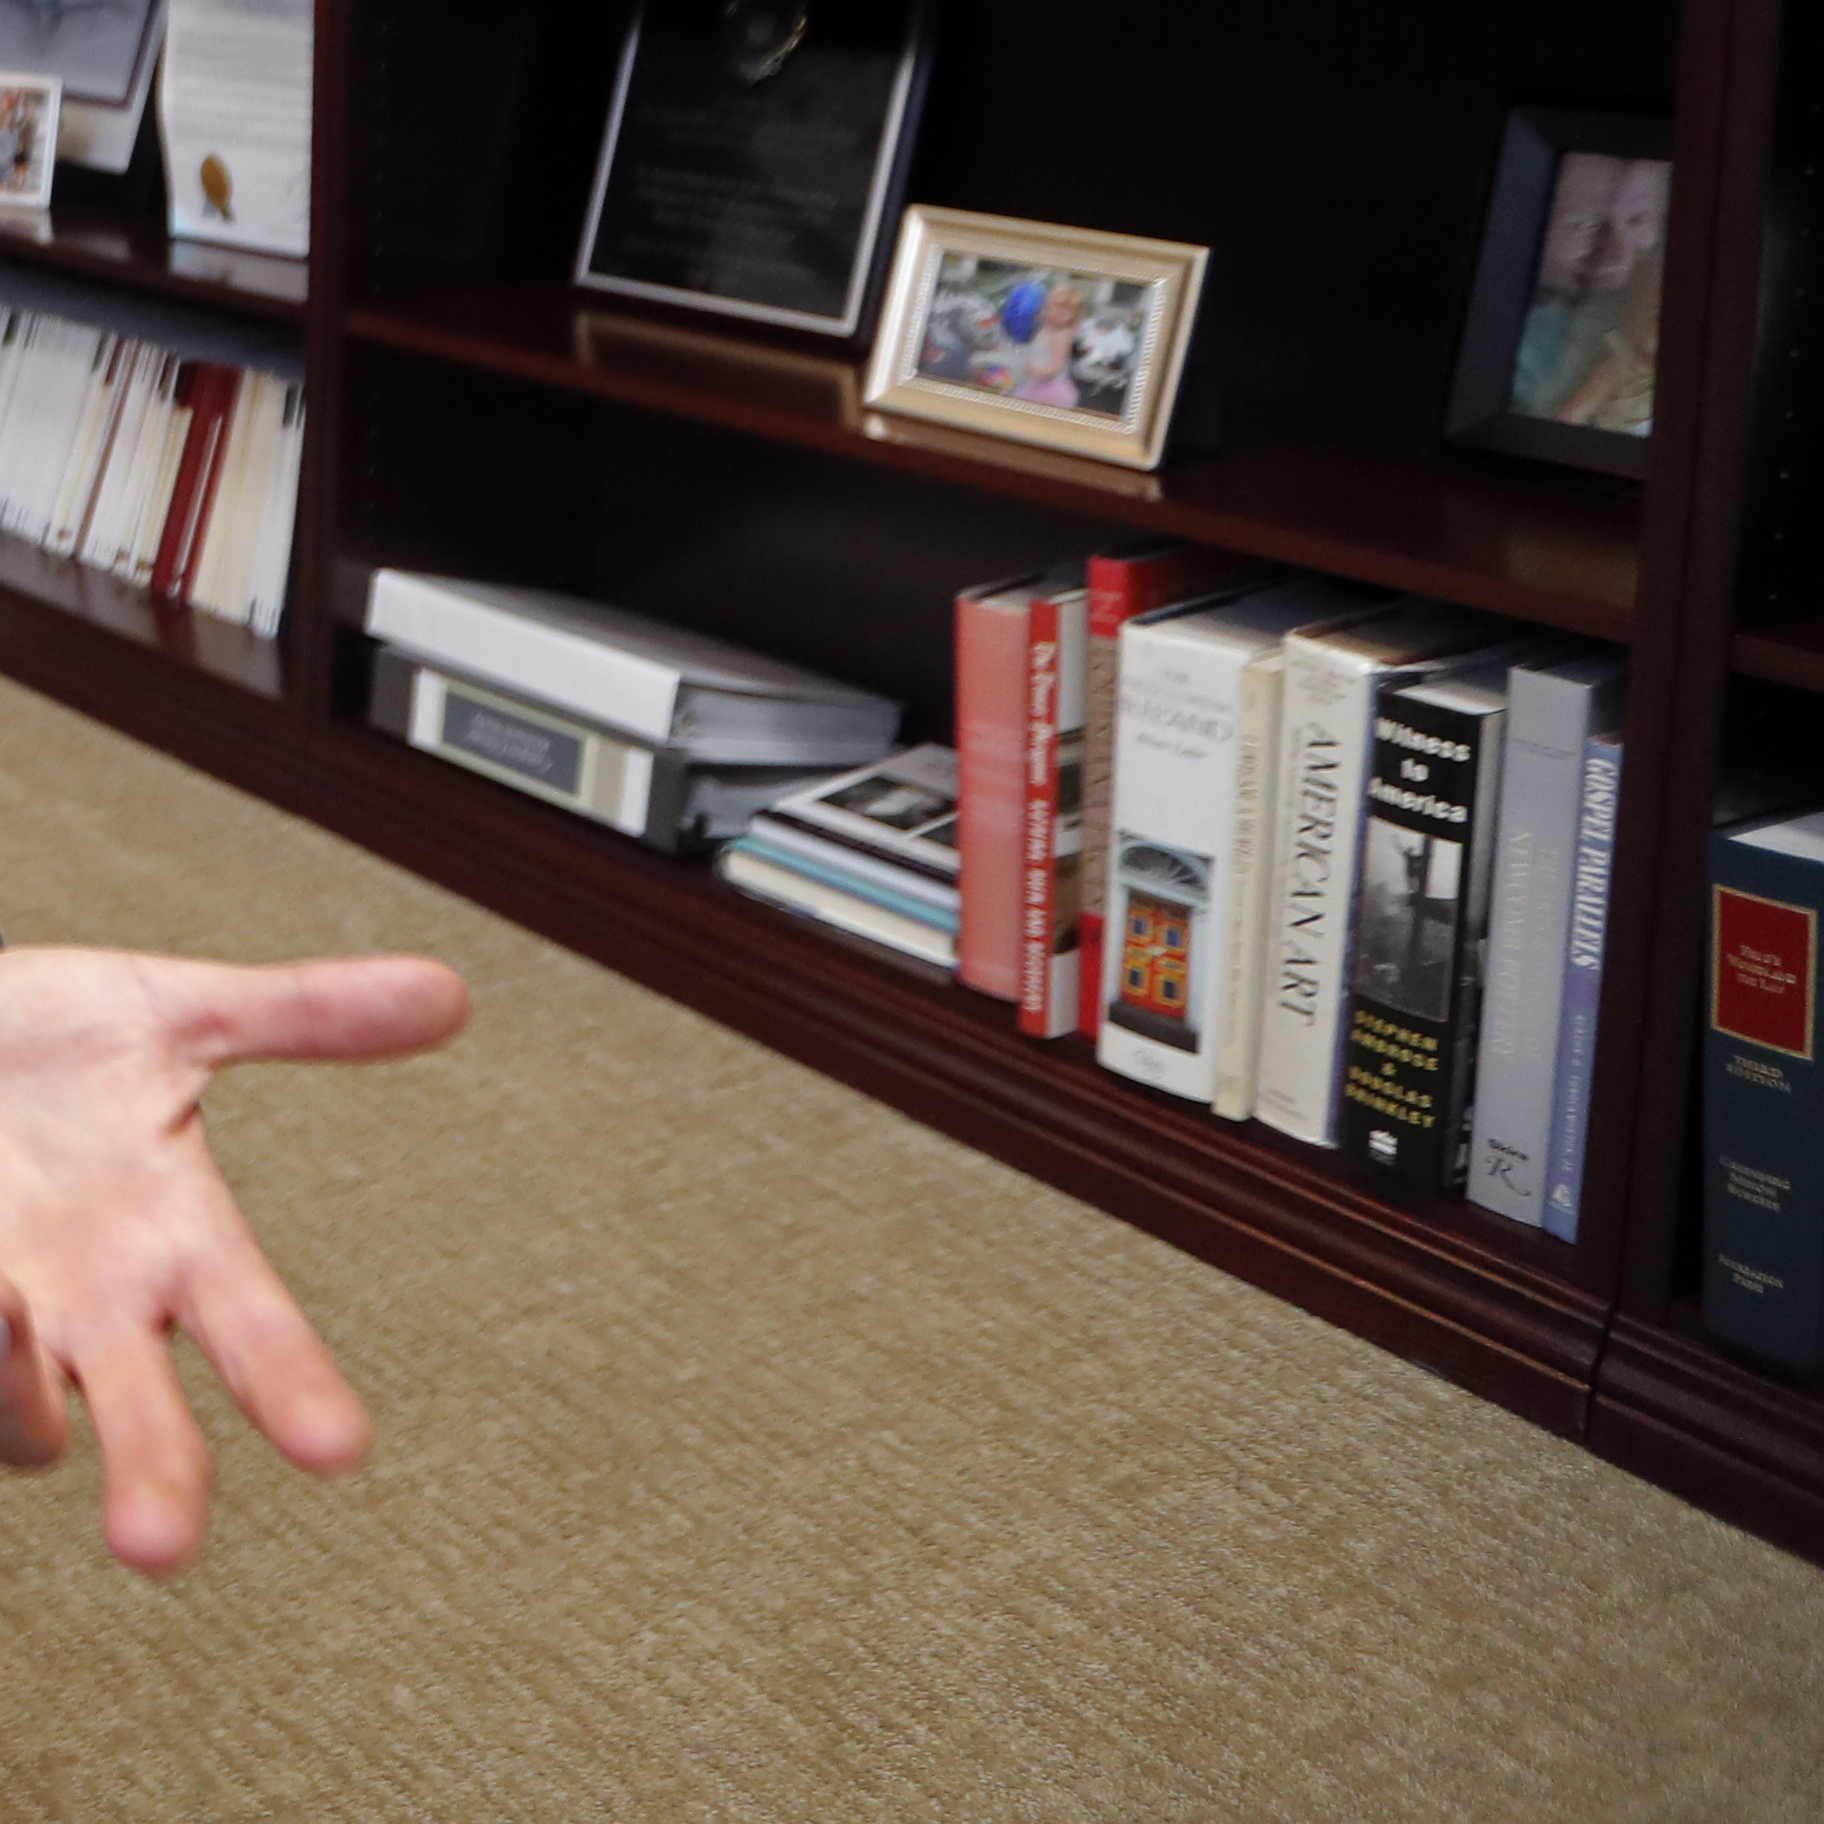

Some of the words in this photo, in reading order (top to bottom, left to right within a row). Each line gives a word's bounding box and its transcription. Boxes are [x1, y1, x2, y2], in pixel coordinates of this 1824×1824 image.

[1375, 716, 1471, 763] Witness
[1400, 758, 1429, 783] to
[1368, 777, 1469, 824] America
[1581, 758, 1618, 841] GOSPEL
[1288, 722, 1341, 939] AMERICAN
[1570, 845, 1611, 971] PARALLELS
[1280, 939, 1321, 1028] ART
[1350, 1028, 1440, 1072] AMBROSE
[1354, 1009, 1439, 1052] STEPHEN
[1344, 1082, 1437, 1129] BRINKLEY
[1348, 1065, 1434, 1109] DOUGLAS
